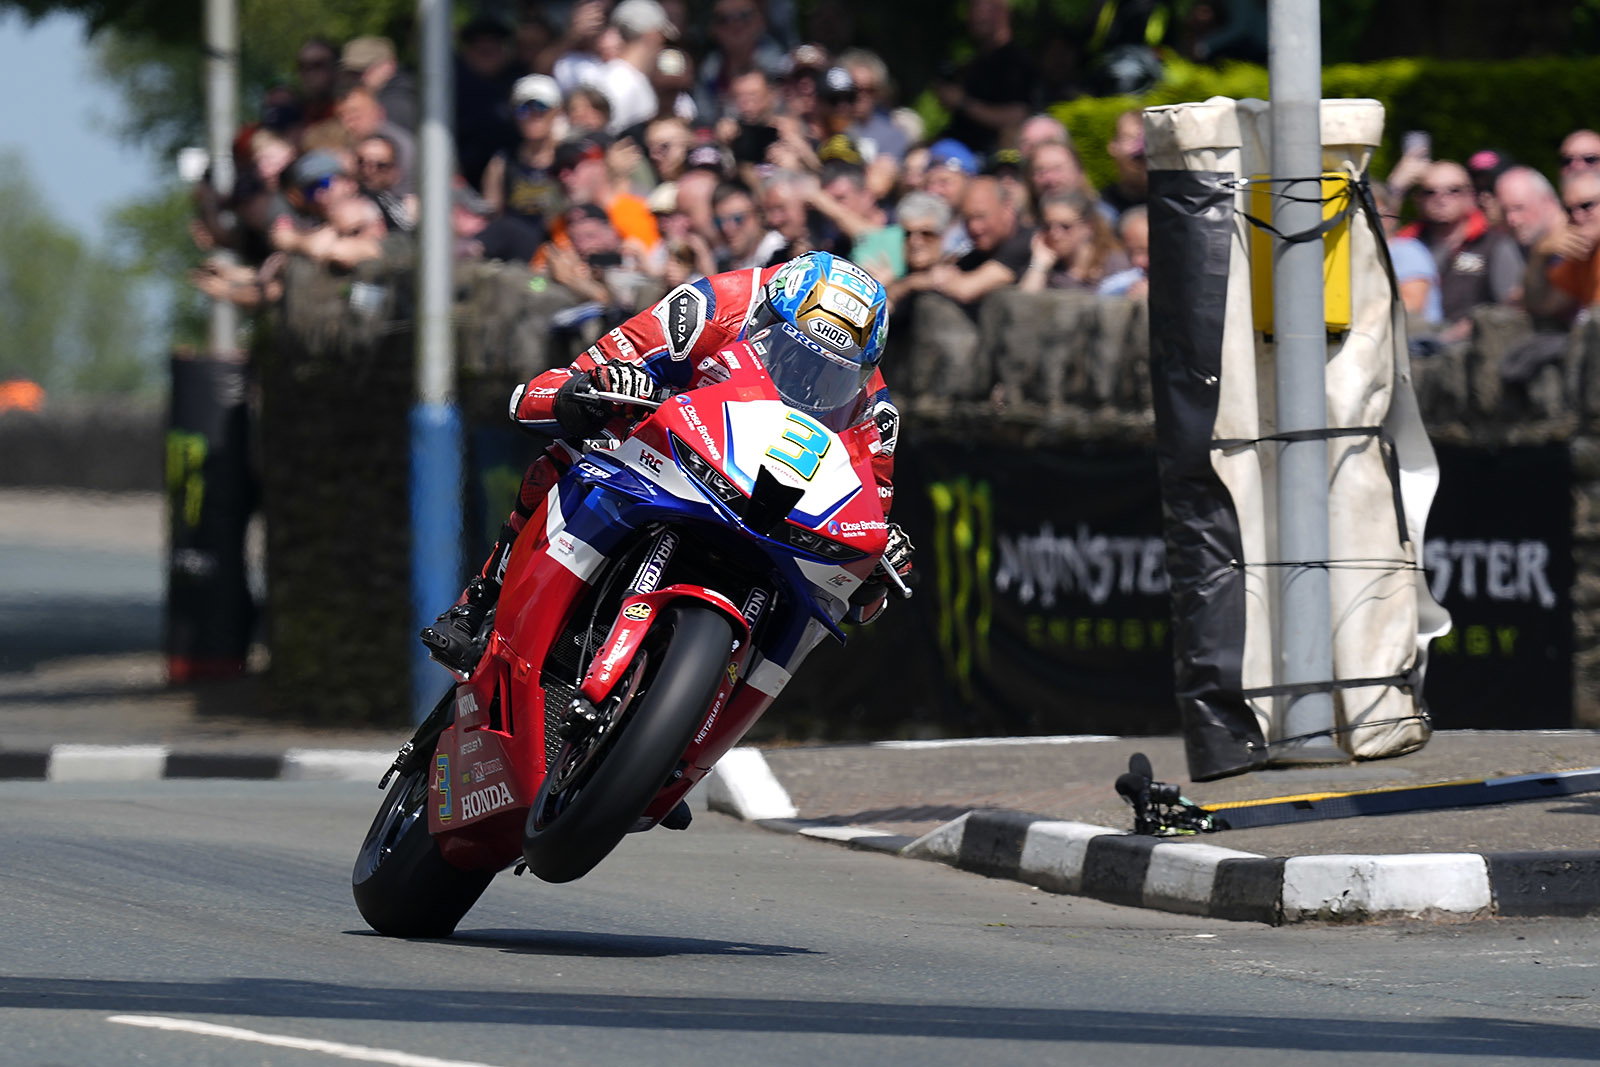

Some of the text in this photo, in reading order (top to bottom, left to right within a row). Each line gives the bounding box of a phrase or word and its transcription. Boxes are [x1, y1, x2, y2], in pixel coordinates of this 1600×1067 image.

[677, 297, 689, 343] SPADA
[813, 321, 849, 347] SHOEI
[609, 327, 634, 358] OTUL
[684, 404, 722, 461] Close Brothers
[766, 410, 832, 482] 3
[878, 419, 895, 434] ADA
[840, 521, 861, 532] Close
[638, 533, 676, 595] MAXTON
[996, 520, 1171, 609] MONSTE
[1424, 538, 1555, 609] STER
[743, 592, 767, 627] TON
[694, 702, 722, 745] METZELER
[461, 781, 515, 821] HONDA
